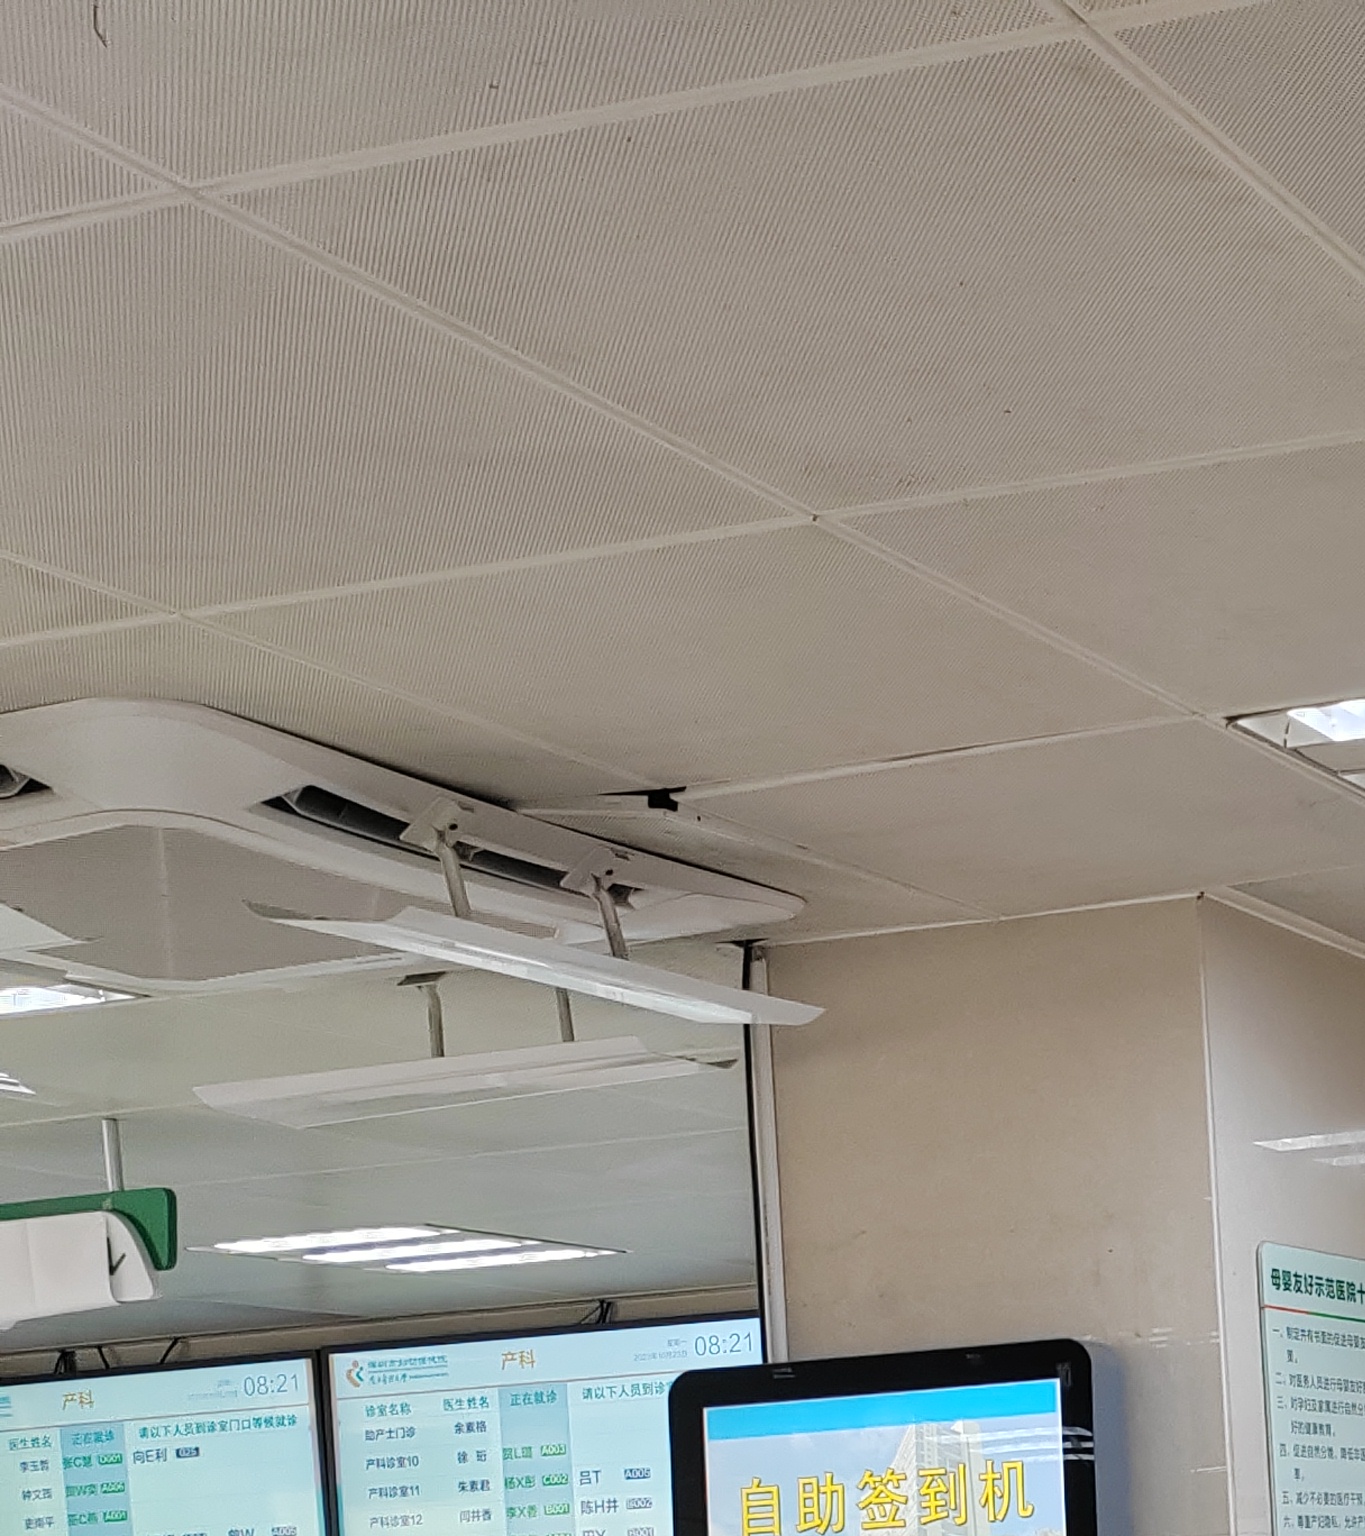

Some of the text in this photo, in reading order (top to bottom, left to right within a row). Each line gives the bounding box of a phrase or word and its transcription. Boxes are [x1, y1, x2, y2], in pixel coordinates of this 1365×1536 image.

[693, 1331, 753, 1358] 08:21
[501, 1349, 536, 1371] 产科
[243, 1374, 300, 1399] 08:21
[582, 1380, 673, 1401] 请以下人员到诊
[62, 1389, 95, 1411] 产科
[442, 1395, 490, 1412] 医生姓名
[510, 1389, 558, 1407] 正在就诊
[365, 1403, 412, 1418] 诊室名称
[138, 1414, 298, 1439] 请以下人员到诊室门口等候就诊
[364, 1426, 416, 1441] 助产士门诊
[365, 1455, 420, 1470] 产科诊室10
[368, 1485, 421, 1500] 产科诊室11
[369, 1513, 423, 1528] 产科诊室12
